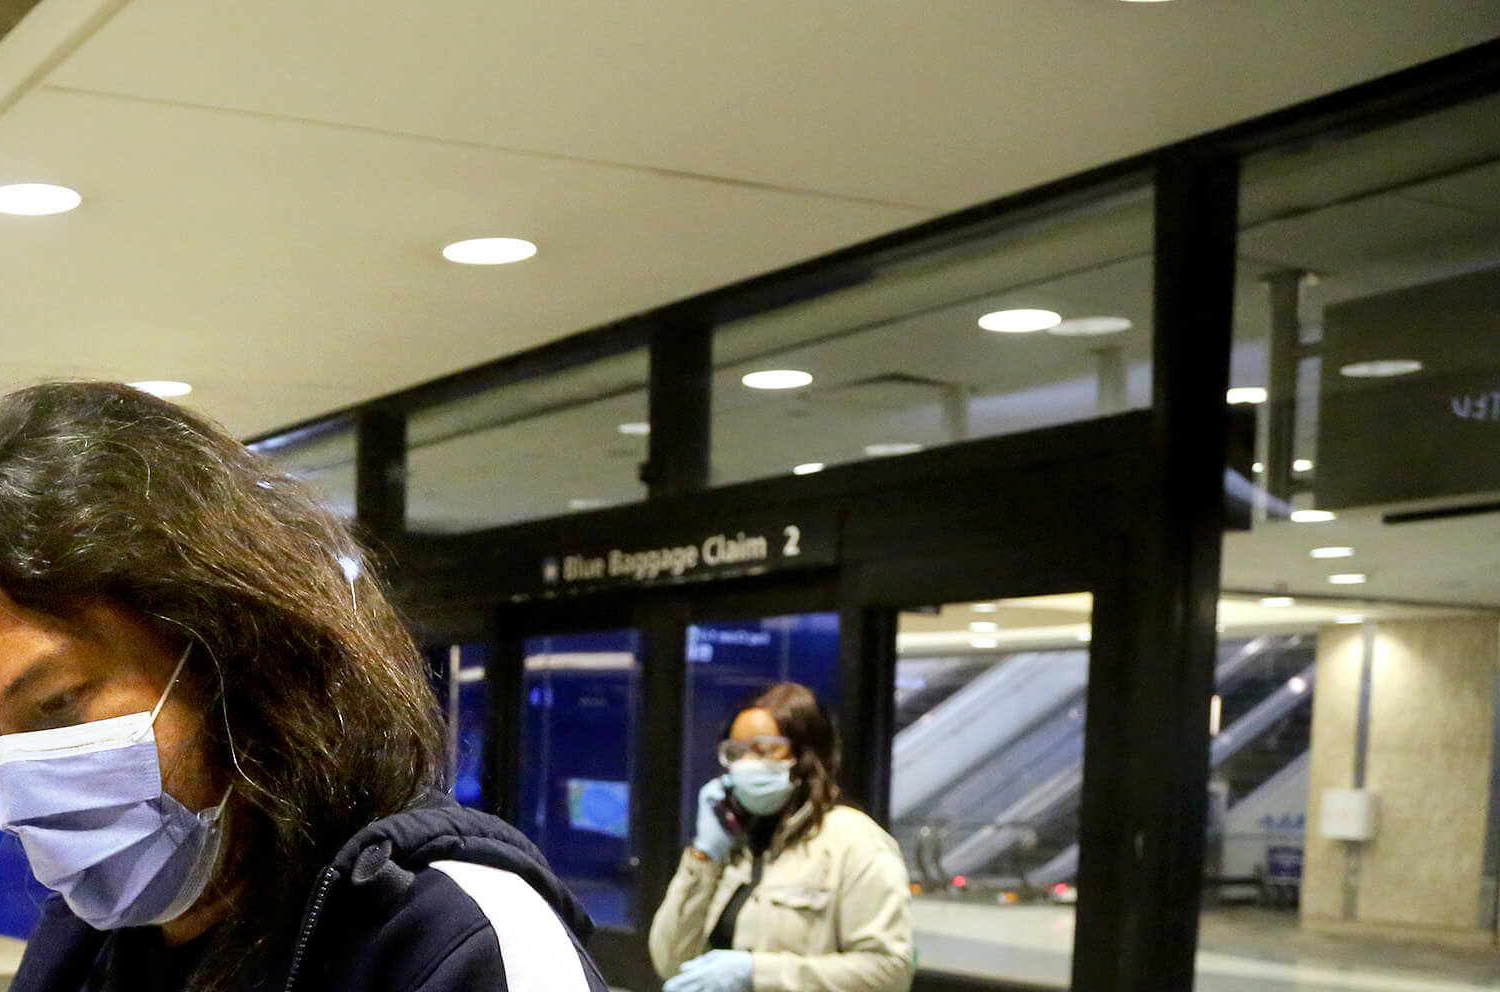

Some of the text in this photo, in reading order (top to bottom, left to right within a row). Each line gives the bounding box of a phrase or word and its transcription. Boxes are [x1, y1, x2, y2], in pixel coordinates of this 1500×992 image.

[562, 525, 800, 580] Blue Baggage Claim 2
